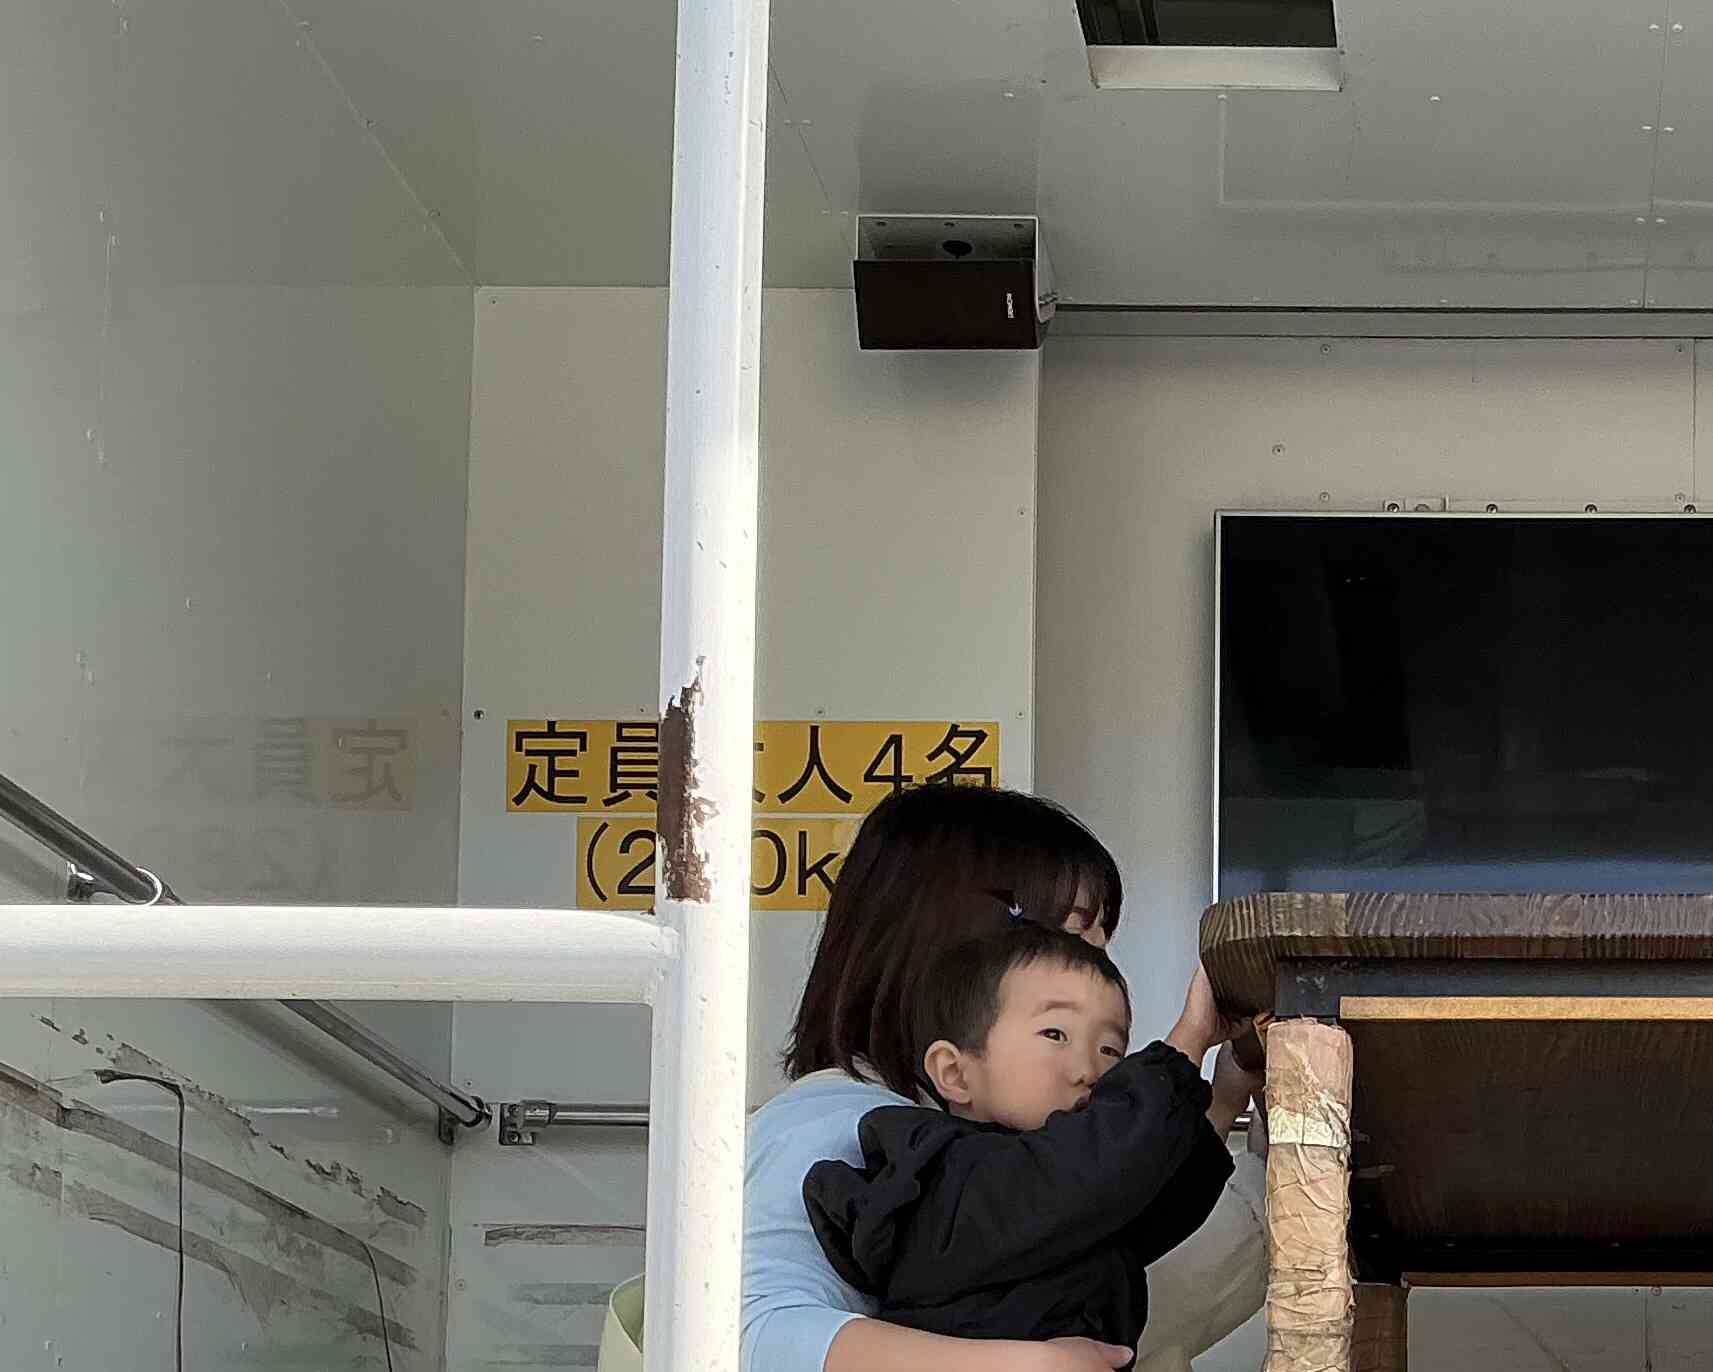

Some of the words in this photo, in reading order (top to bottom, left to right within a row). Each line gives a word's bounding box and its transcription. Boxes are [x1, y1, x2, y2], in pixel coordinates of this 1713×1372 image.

[512, 720, 994, 805] 定員人4名
[585, 822, 842, 902] (20k
